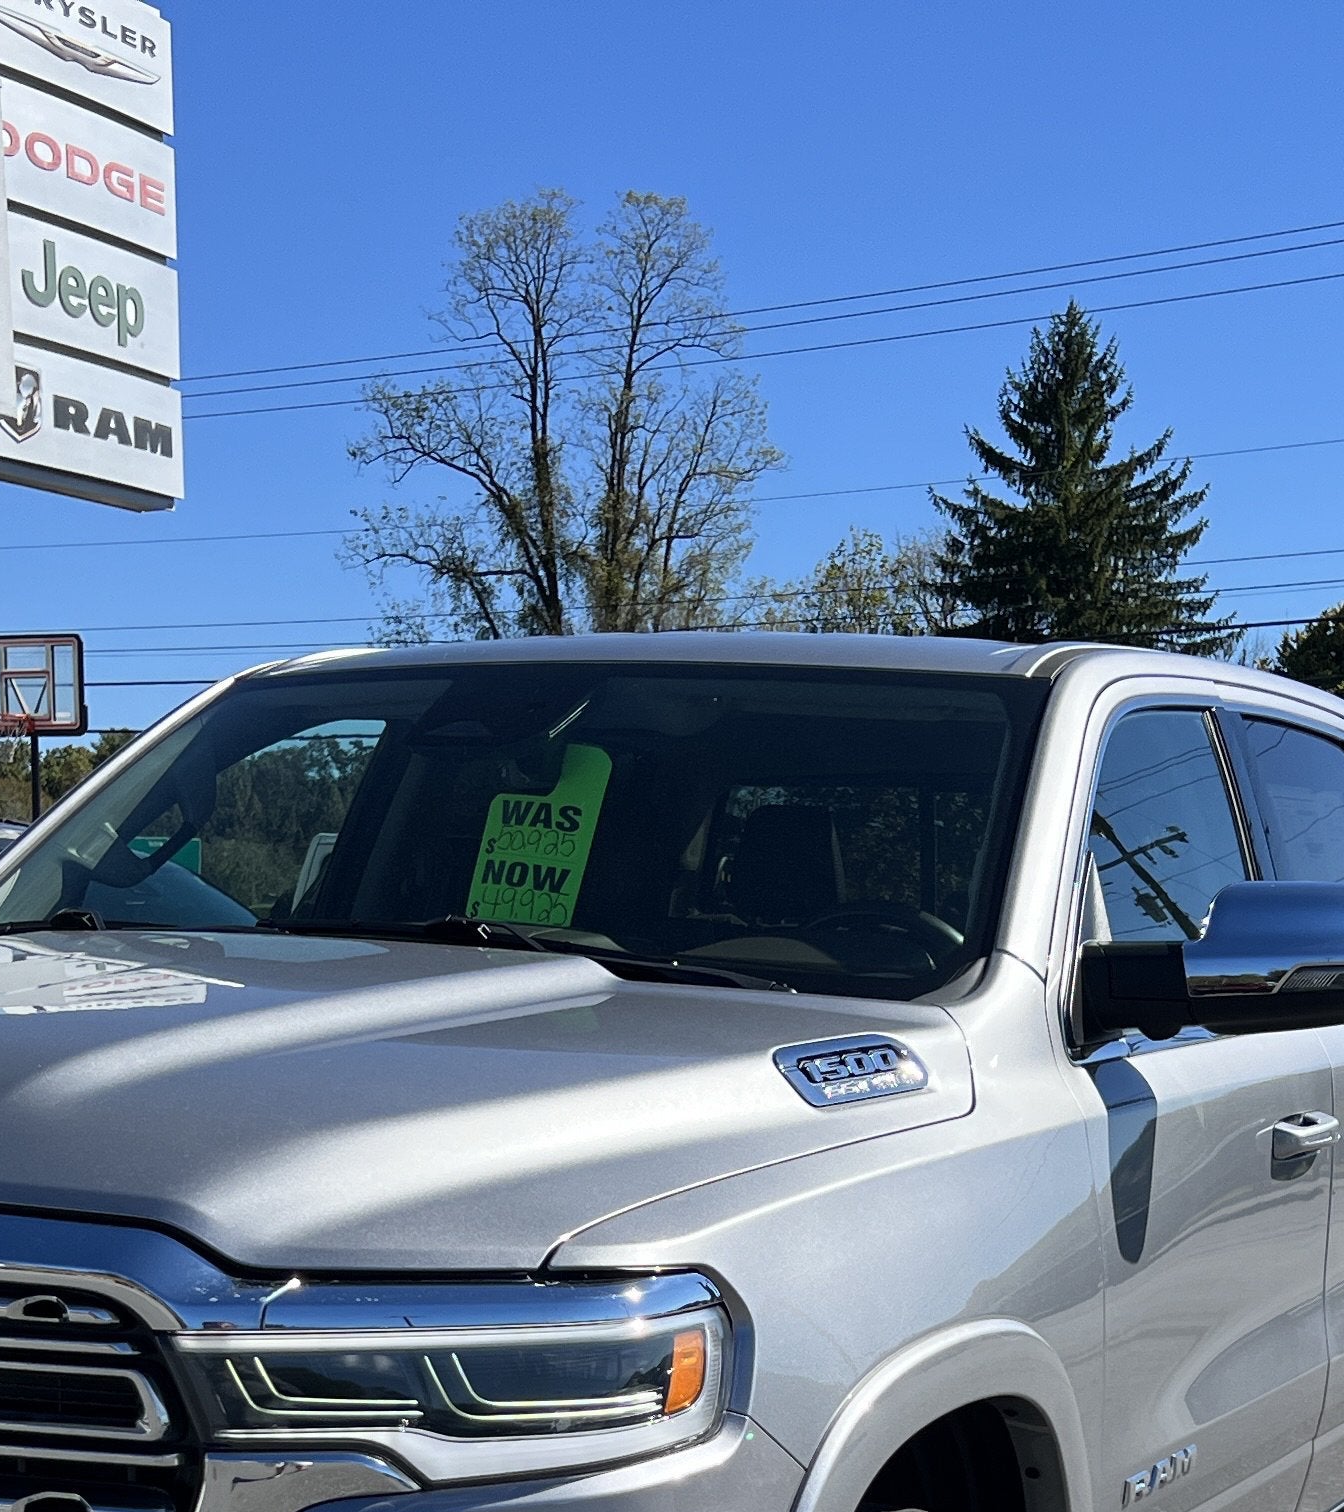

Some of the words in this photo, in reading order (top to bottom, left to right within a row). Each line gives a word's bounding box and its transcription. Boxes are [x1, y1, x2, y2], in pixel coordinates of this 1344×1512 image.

[21, 239, 145, 347] Jeep
[53, 394, 173, 459] RAM
[502, 799, 583, 833] WAS
[481, 859, 571, 893] NOW
[799, 1047, 899, 1084] 1500
[1121, 1443, 1197, 1507] RAM
